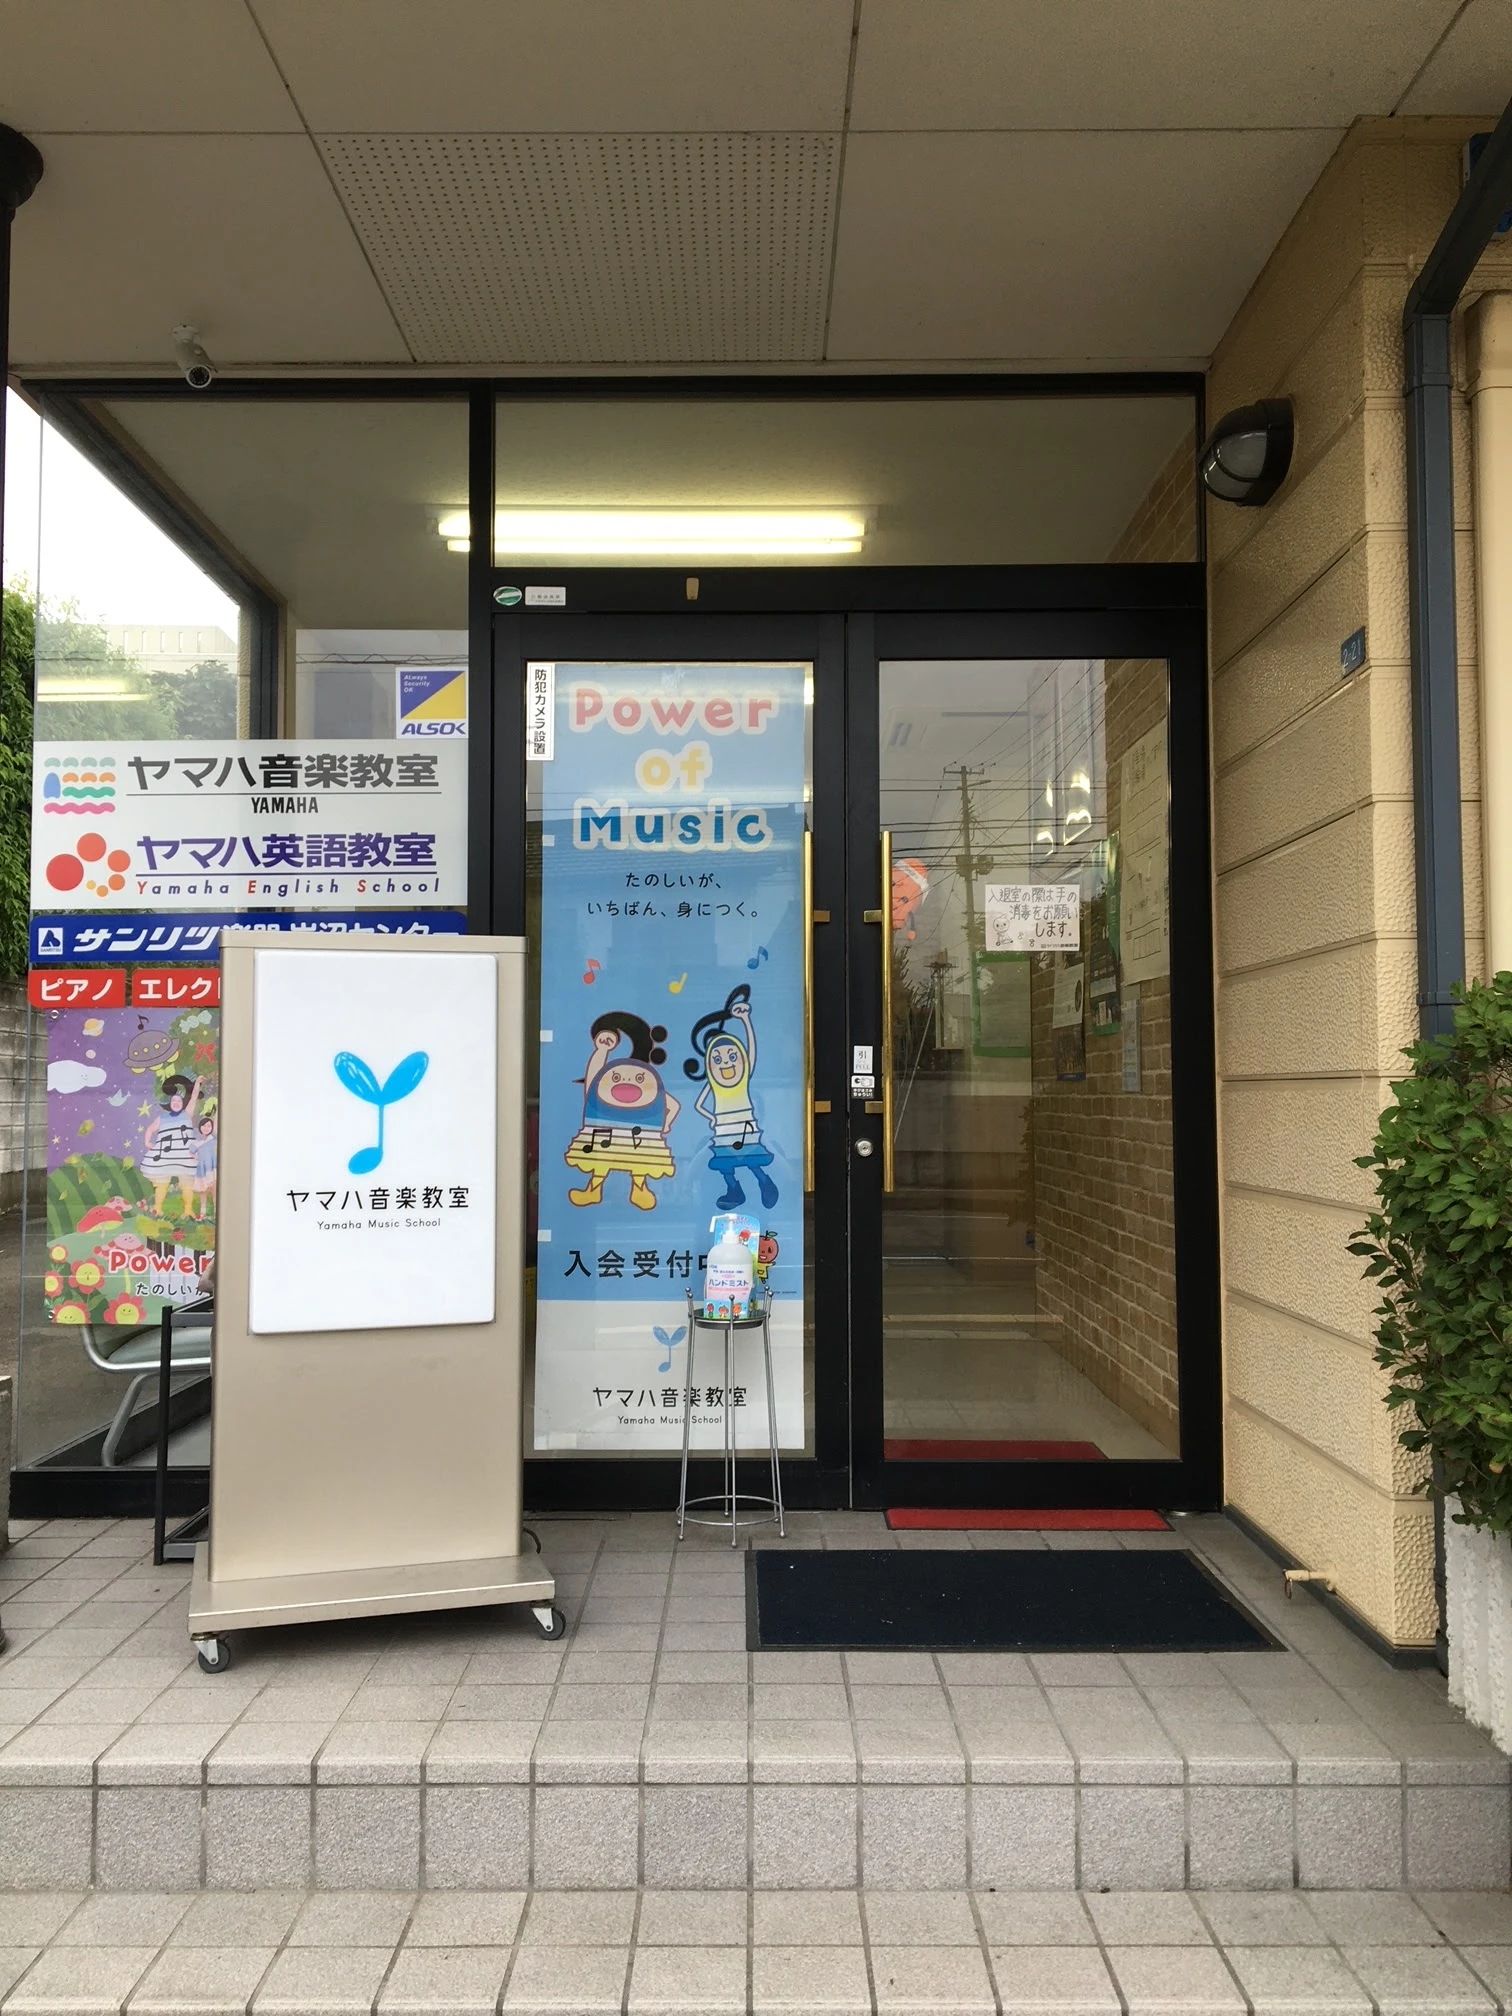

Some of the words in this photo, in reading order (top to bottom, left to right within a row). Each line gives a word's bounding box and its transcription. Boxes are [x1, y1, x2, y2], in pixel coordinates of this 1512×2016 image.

[534, 669, 547, 755] 防犯カメラ設置
[573, 685, 774, 731] Power
[401, 722, 466, 736] ALSOK
[127, 753, 440, 790] ヤマハ音楽教室
[638, 745, 708, 789] of
[251, 796, 319, 814] YAMAHA
[577, 803, 769, 847] Music
[136, 832, 437, 870] ヤマハ英語教室
[136, 880, 230, 895] Yamaha
[248, 878, 340, 898] English
[356, 877, 440, 893] School
[625, 872, 722, 889] たのしいが、
[587, 901, 759, 918] いちばん、身につく。
[41, 977, 113, 1001] ピアノ
[139, 977, 221, 1000] エレク
[286, 1185, 470, 1212] ヤマハ音楽教室
[316, 1220, 362, 1231] Yamaha
[368, 1218, 400, 1229] Music
[405, 1217, 441, 1228] School
[109, 1250, 212, 1274] Power
[709, 1279, 750, 1287] ハンドミスト
[592, 1386, 747, 1408] ヤマハ音楽教室
[617, 1415, 655, 1425] Yamaha
[660, 1415, 687, 1425] Music
[691, 1415, 723, 1424] School
